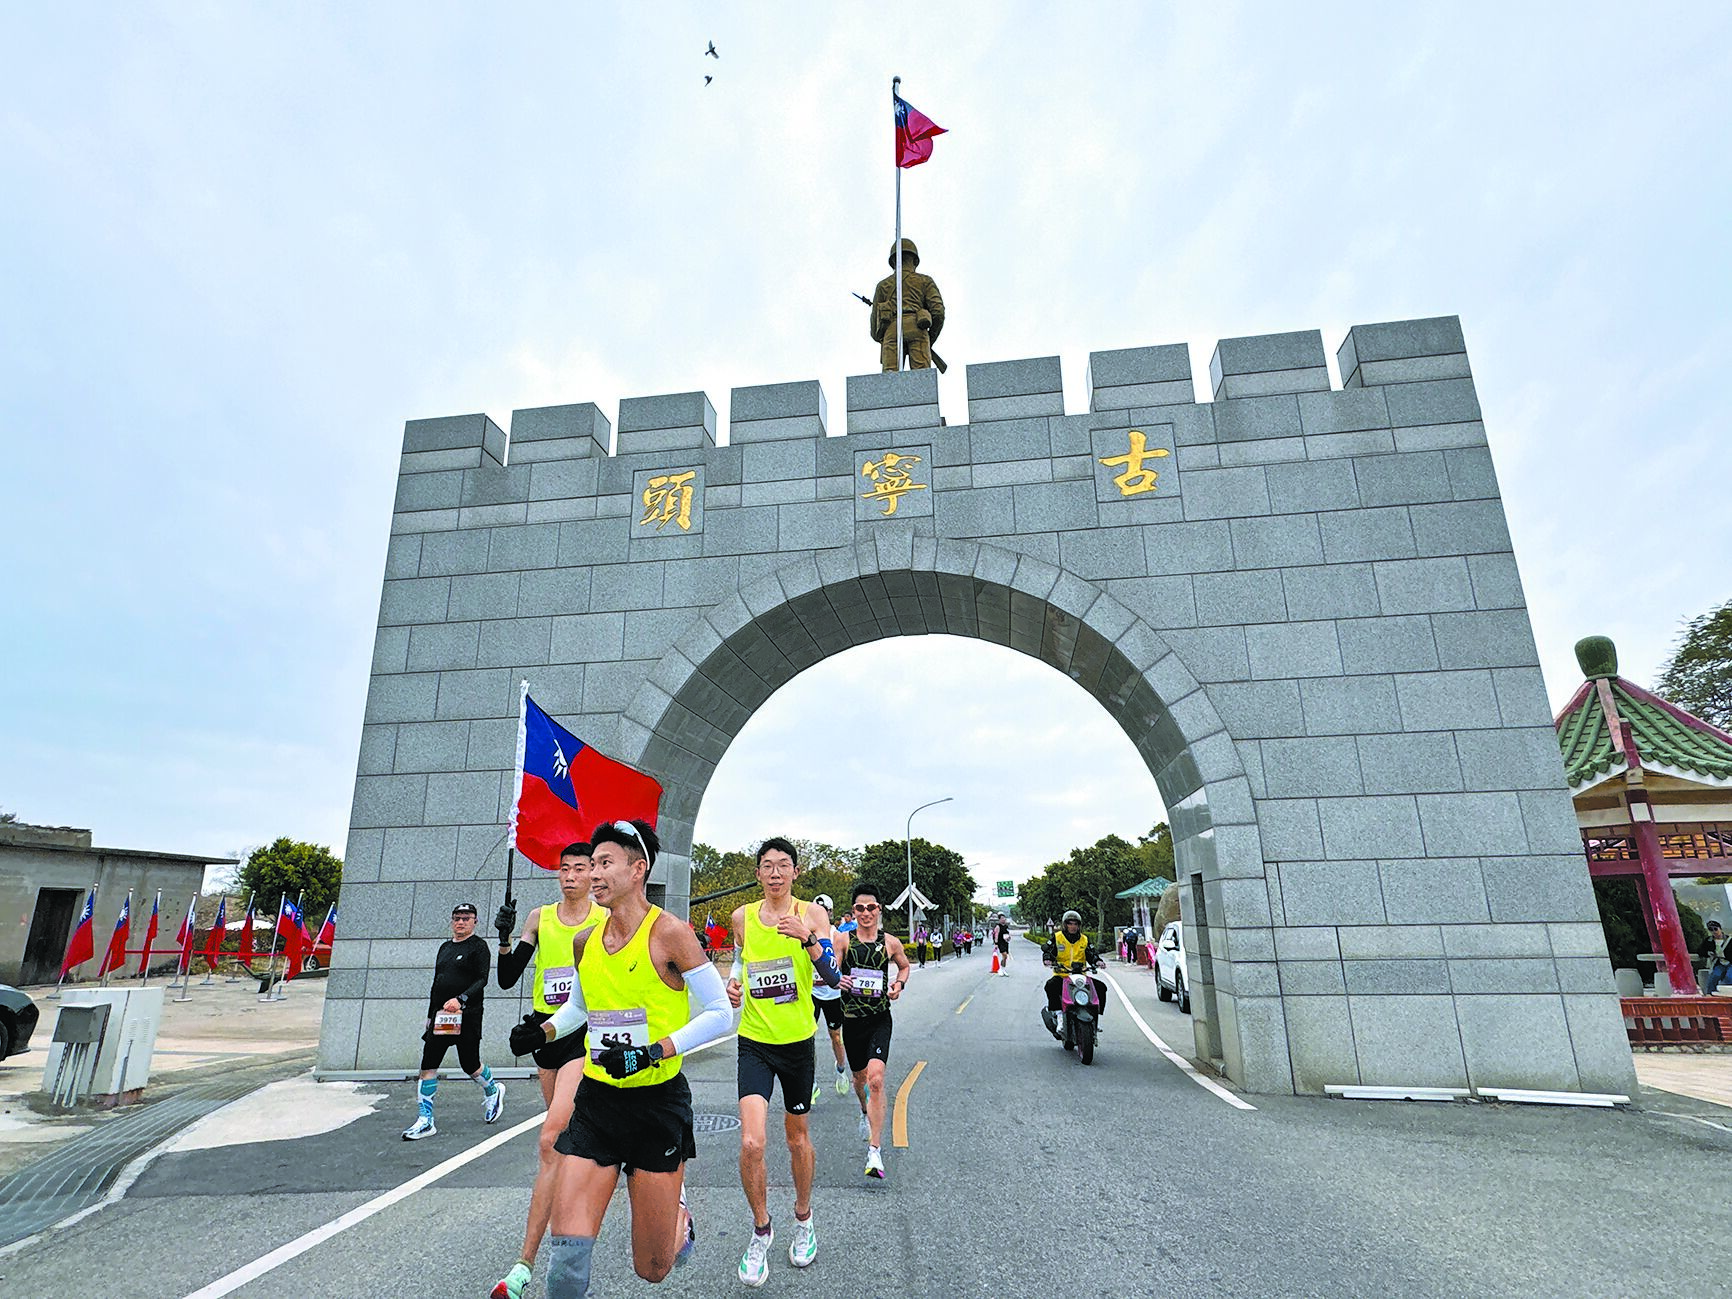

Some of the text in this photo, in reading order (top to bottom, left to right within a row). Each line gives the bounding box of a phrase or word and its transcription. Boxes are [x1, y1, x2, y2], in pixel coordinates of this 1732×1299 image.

[1098, 430, 1169, 496] 古
[640, 470, 695, 530] 頭
[756, 973, 788, 987] 1029
[859, 979, 876, 988] 787
